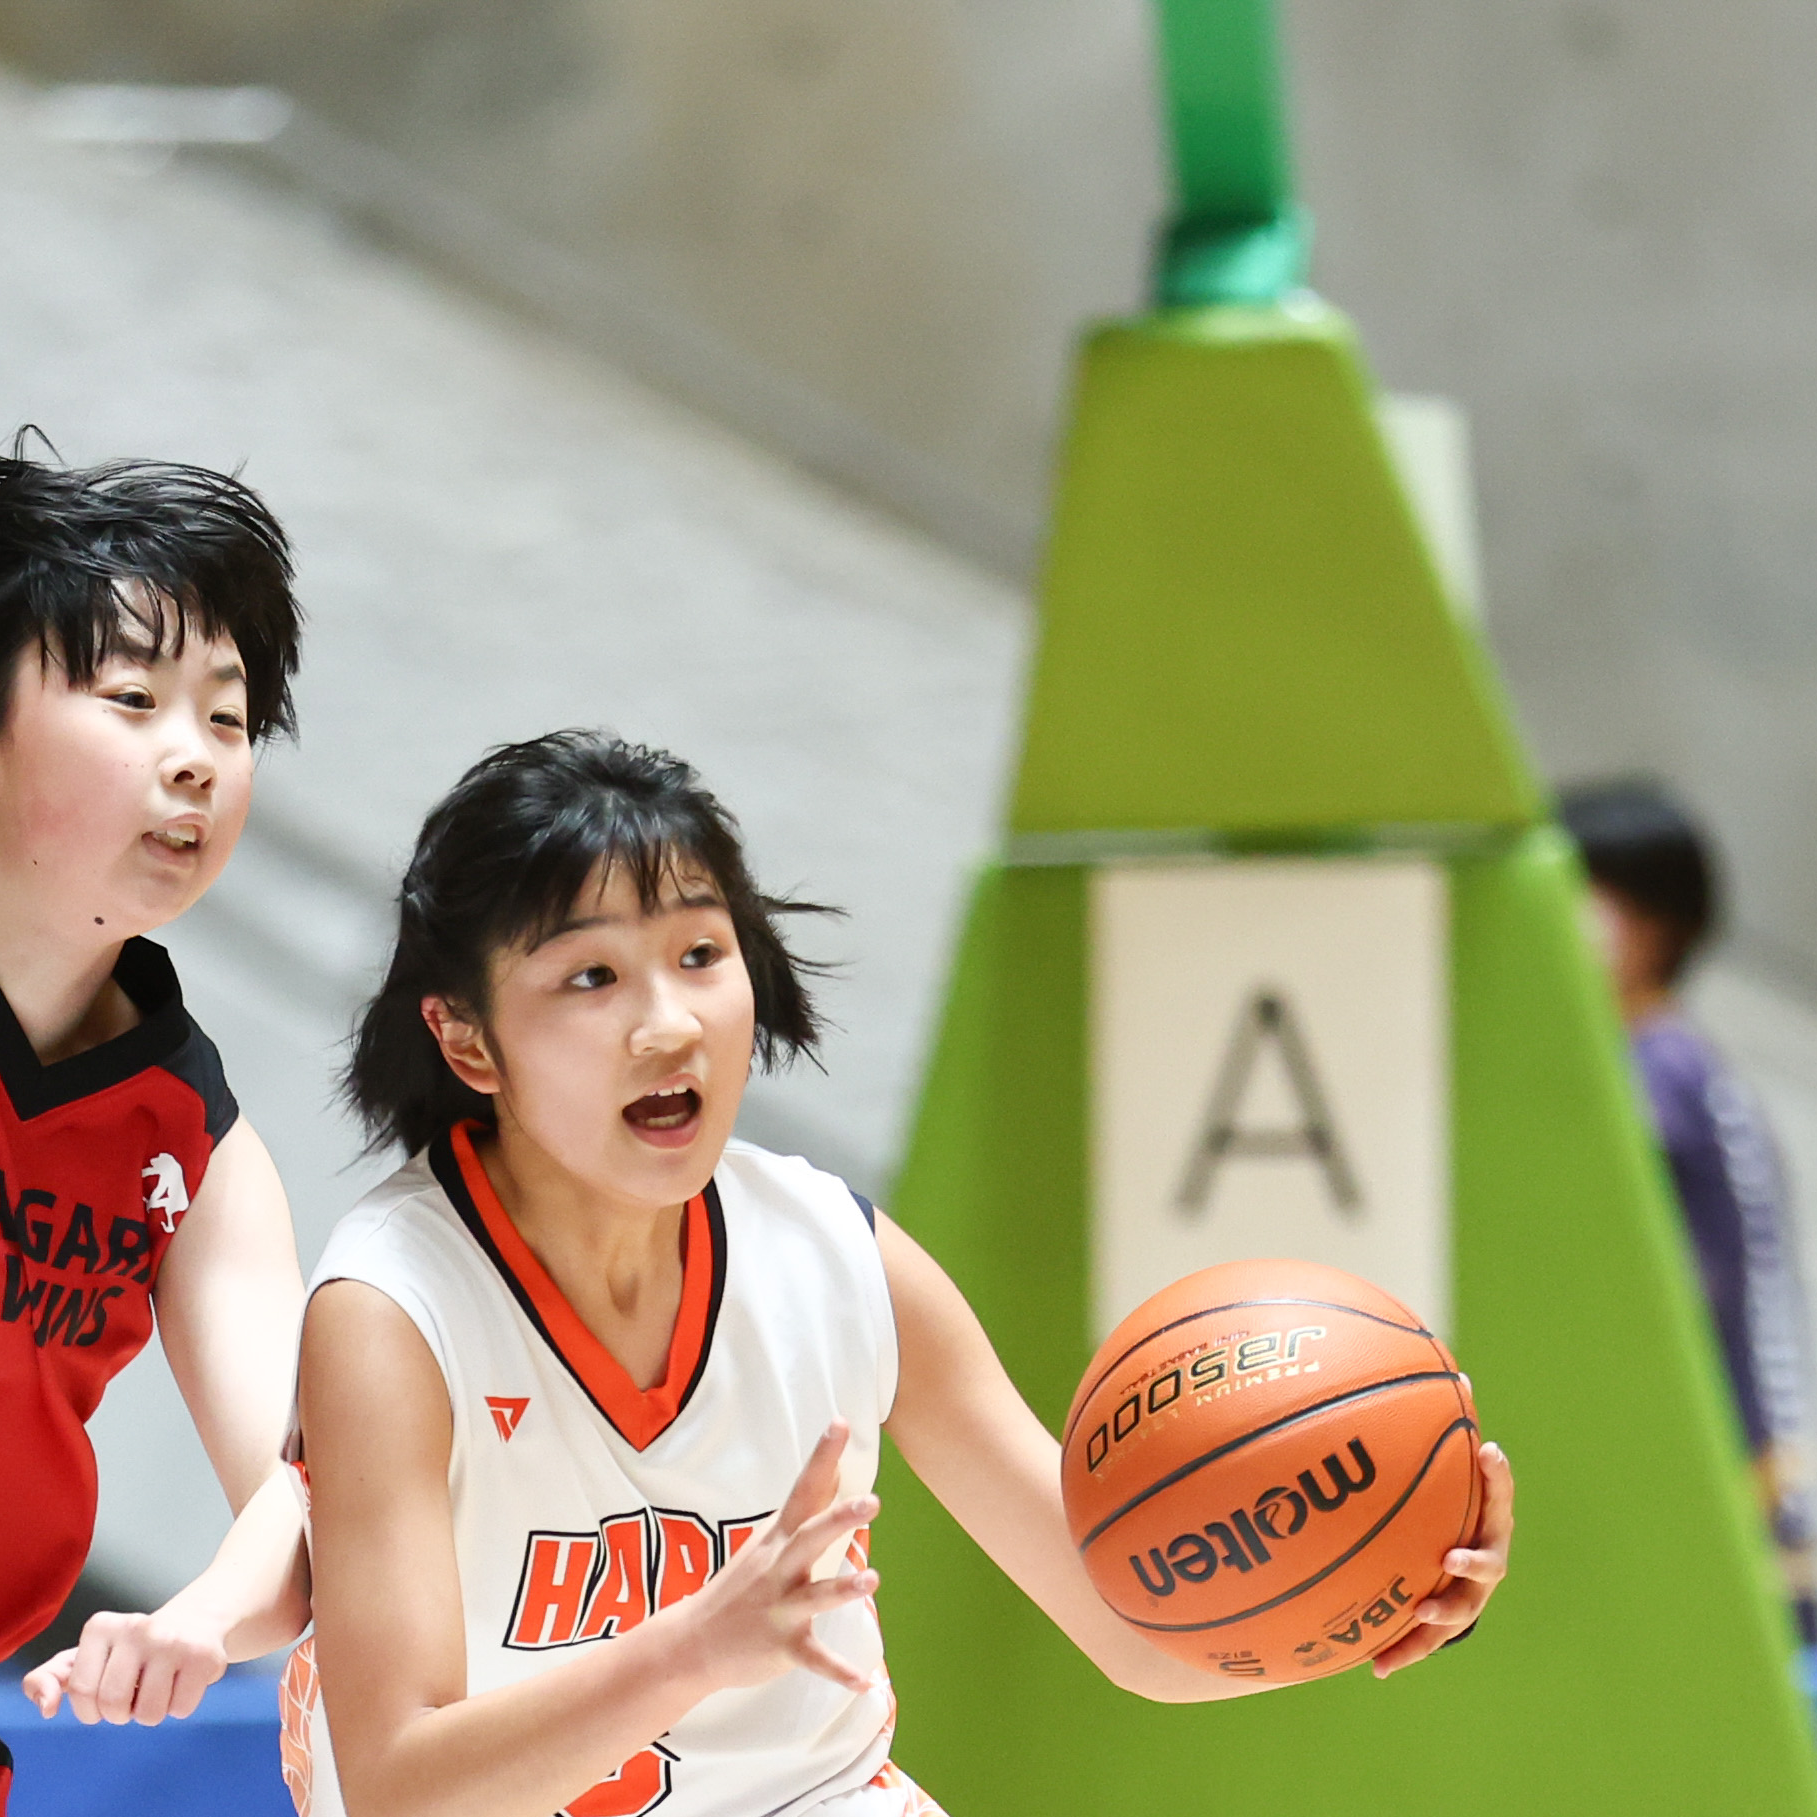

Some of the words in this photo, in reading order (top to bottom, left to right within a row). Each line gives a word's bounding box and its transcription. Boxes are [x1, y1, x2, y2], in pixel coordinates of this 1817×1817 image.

[1173, 985, 1369, 1220] A
[1085, 1324, 1327, 1475] JB5000
[1195, 1360, 1321, 1408] PREMIUM
[502, 1504, 778, 1652] HAB
[1129, 1436, 1378, 1598] molten
[1327, 1575, 1415, 1646] JBA
